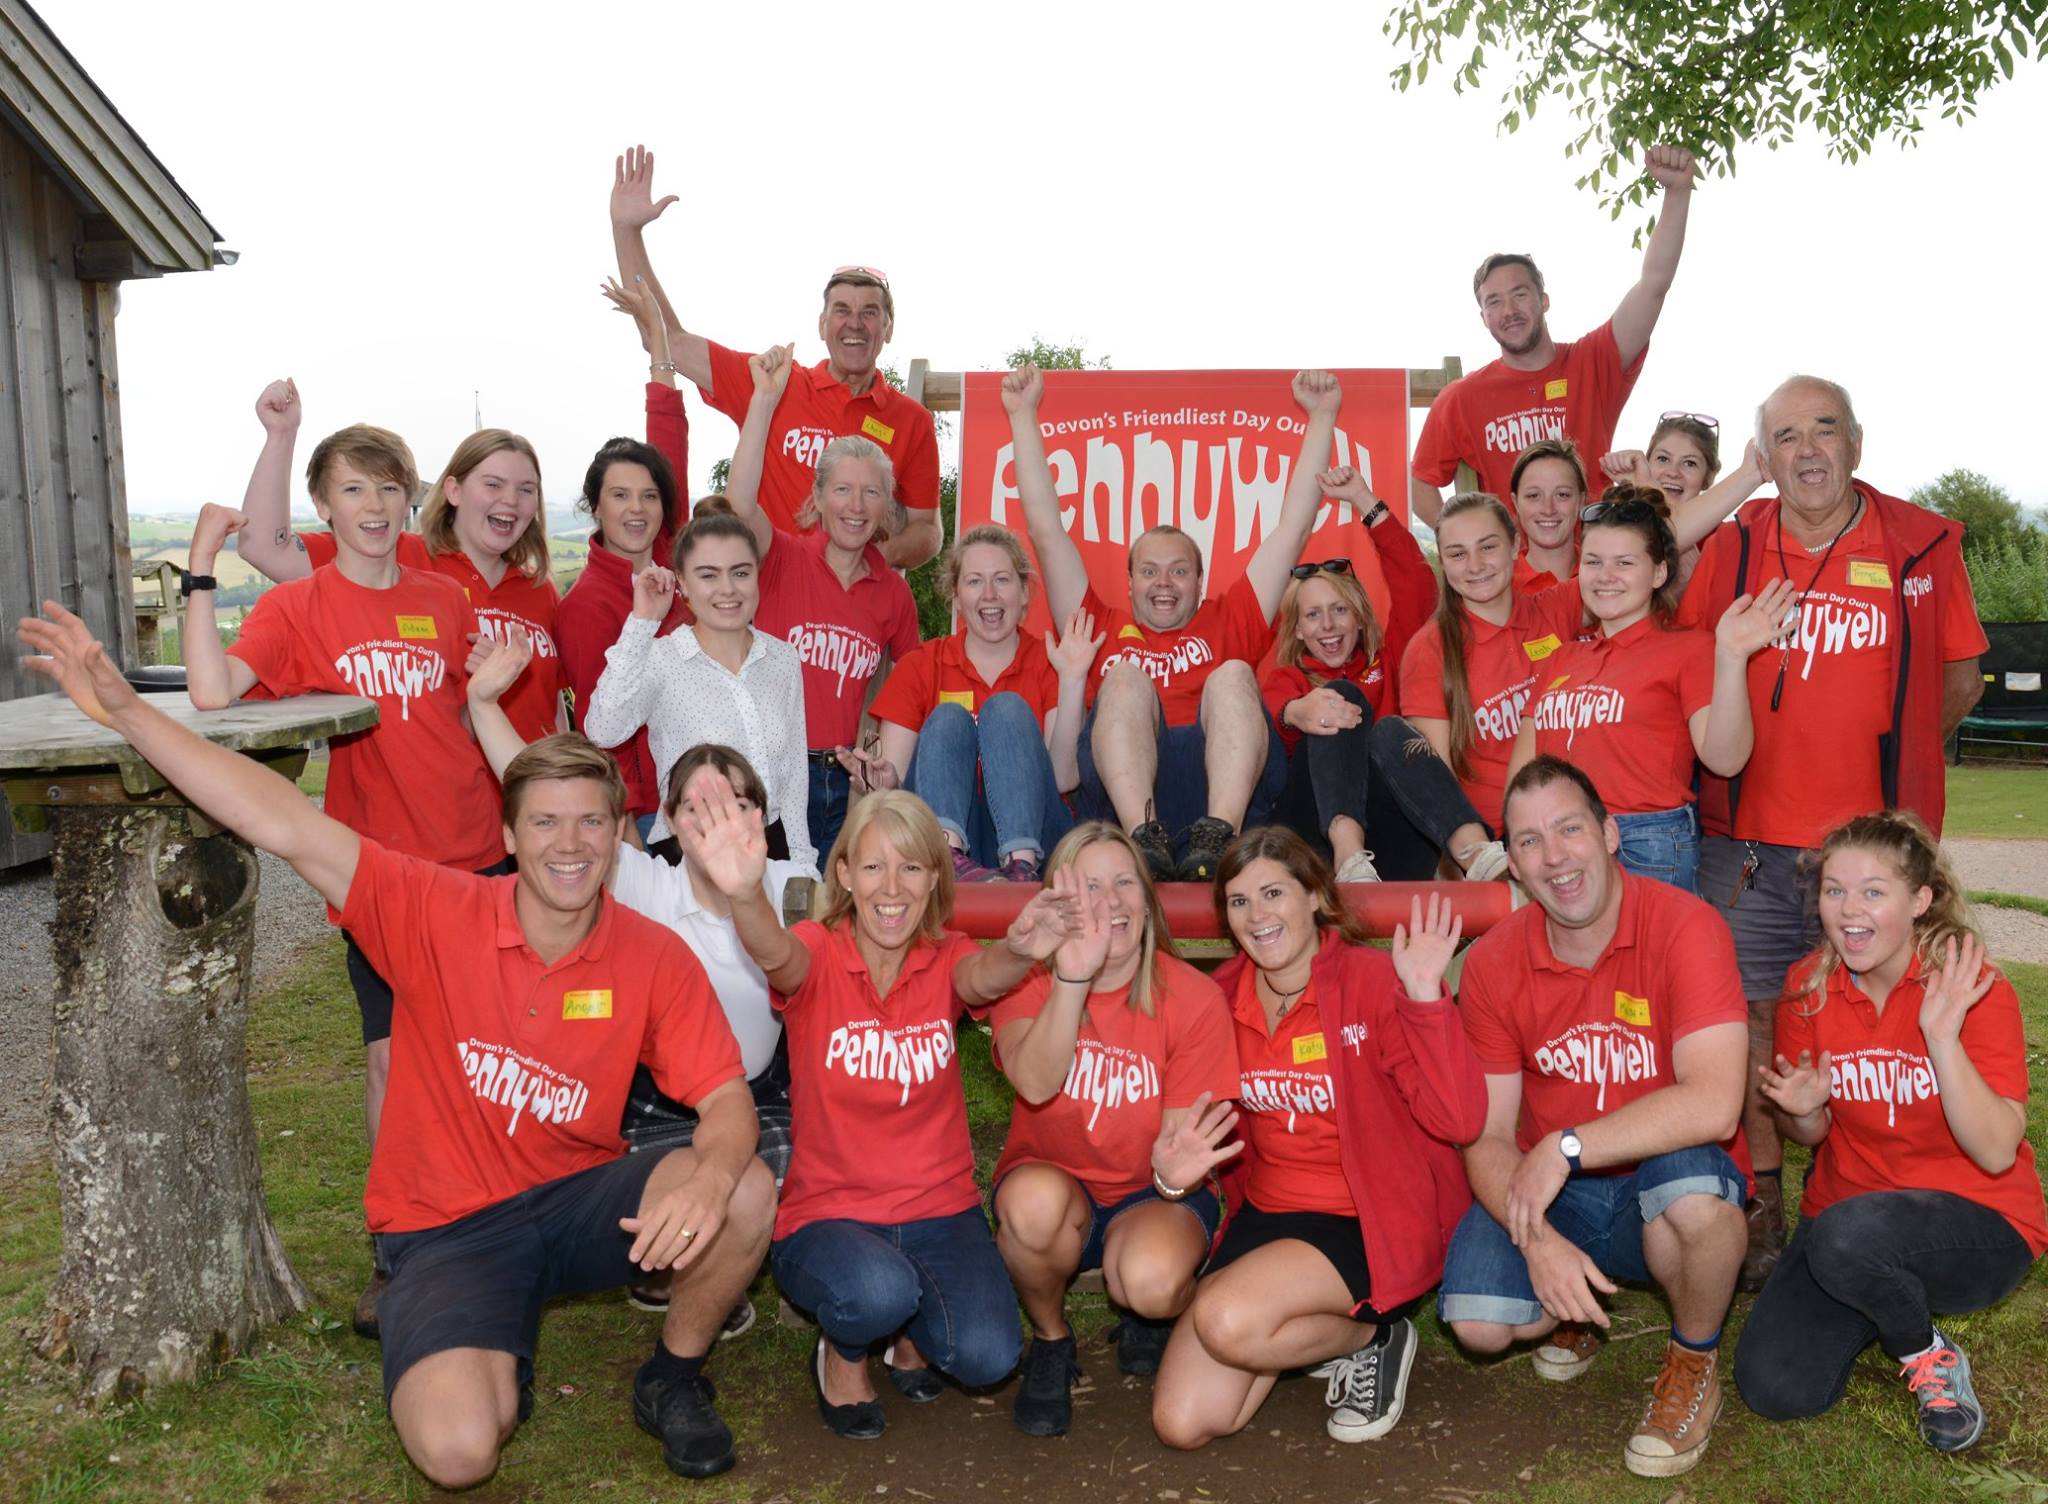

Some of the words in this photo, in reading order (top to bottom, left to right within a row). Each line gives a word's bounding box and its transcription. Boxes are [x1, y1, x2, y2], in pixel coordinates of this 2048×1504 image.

[1040, 412, 1118, 438] Devon's
[1123, 408, 1227, 428] Friendliest
[1233, 410, 1271, 431] Day
[1276, 415, 1306, 435] Ou
[1485, 414, 1565, 453] Pennyw
[1829, 593, 1846, 605] Day
[1848, 598, 1869, 610] Out!
[788, 625, 882, 698] Pennywel
[1100, 636, 1213, 688] Pnnywell
[1534, 688, 1624, 751] ennywell
[848, 1018, 879, 1029] Devon's
[905, 1025, 922, 1035] Day
[469, 1037, 504, 1053] Devon's
[541, 1063, 557, 1078] Day
[825, 1019, 955, 1106] Pennywell
[1288, 1070, 1303, 1080] Day
[1831, 1052, 1854, 1062] evon's
[1239, 1074, 1335, 1134] nnywel
[1830, 1056, 1940, 1128] ennywel
